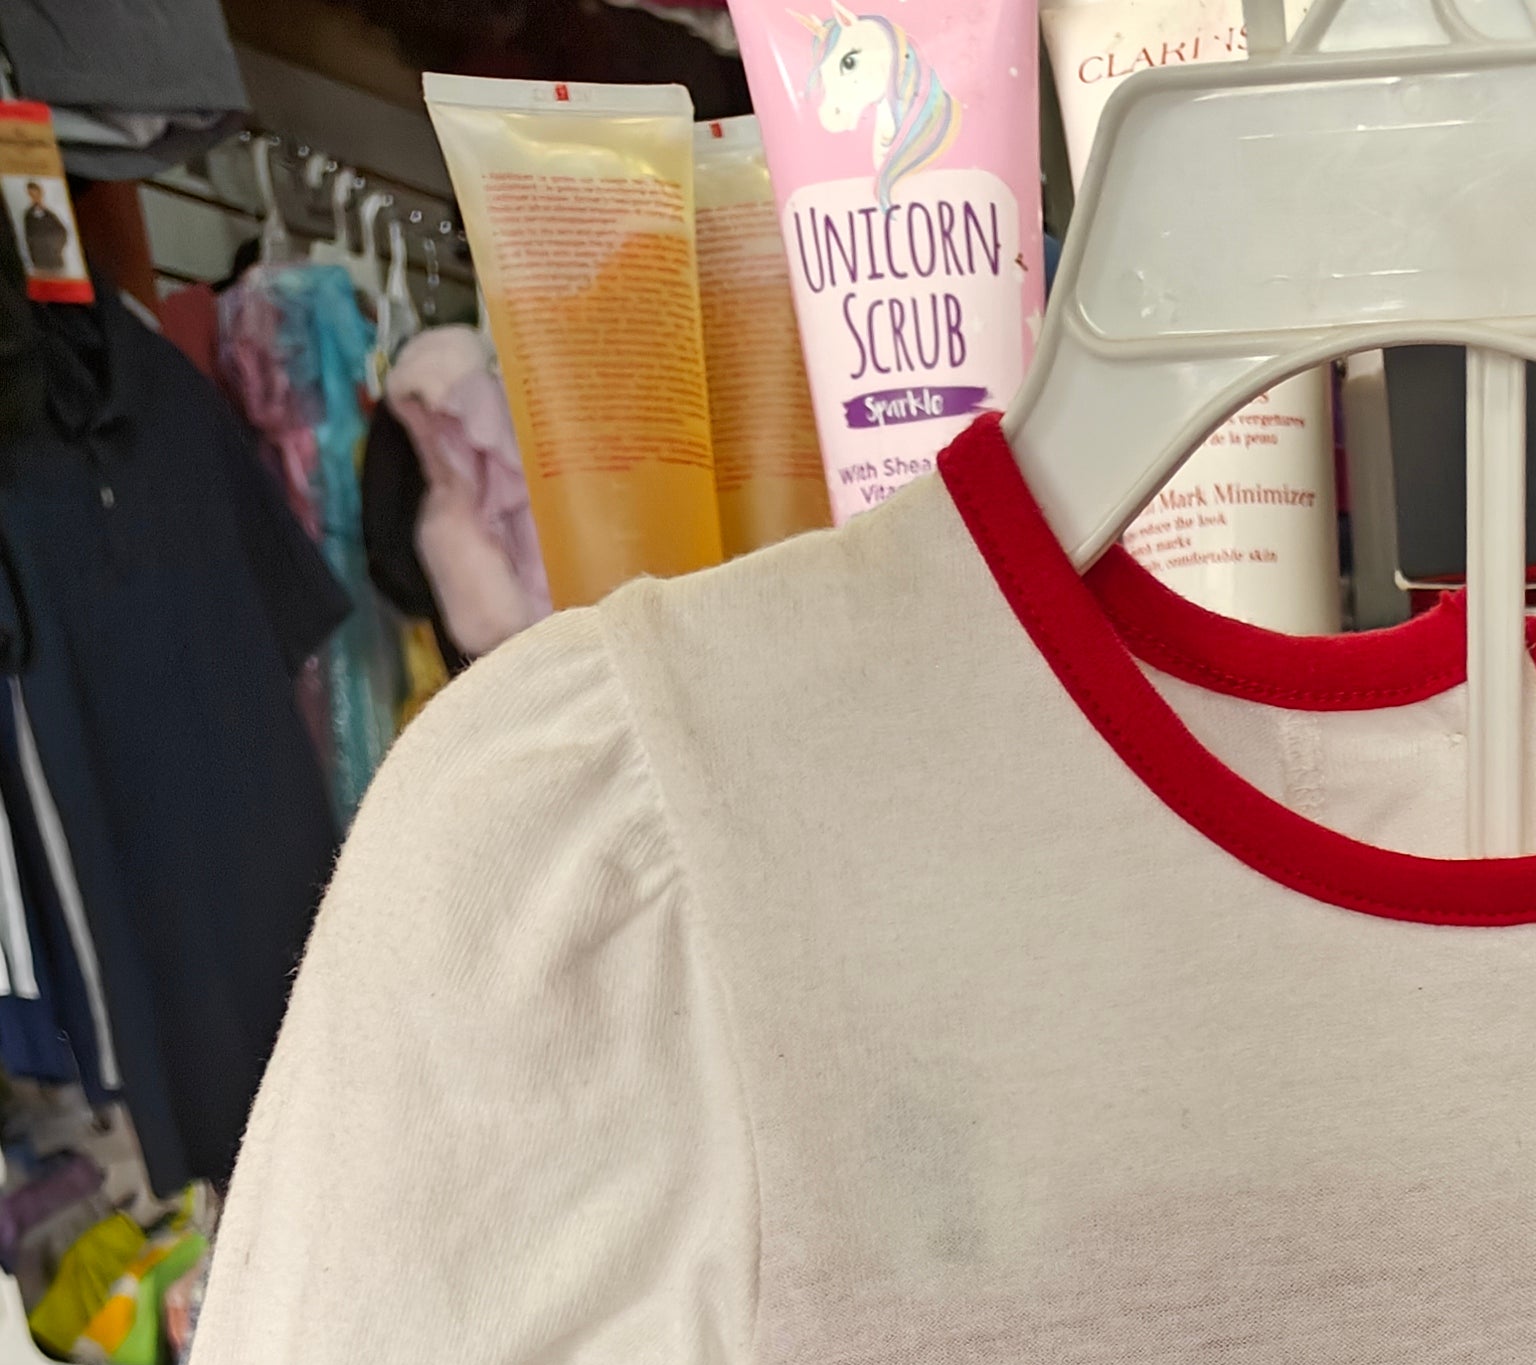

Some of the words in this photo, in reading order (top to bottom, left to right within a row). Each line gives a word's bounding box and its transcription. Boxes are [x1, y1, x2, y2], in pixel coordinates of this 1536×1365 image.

[794, 200, 1000, 293] UNICORN
[842, 292, 966, 379] SCRUB
[864, 388, 944, 426] Sparkle
[838, 462, 878, 485] With
[883, 456, 932, 476] Shea
[1159, 486, 1208, 512] Mark
[1213, 483, 1316, 508] Minimizer
